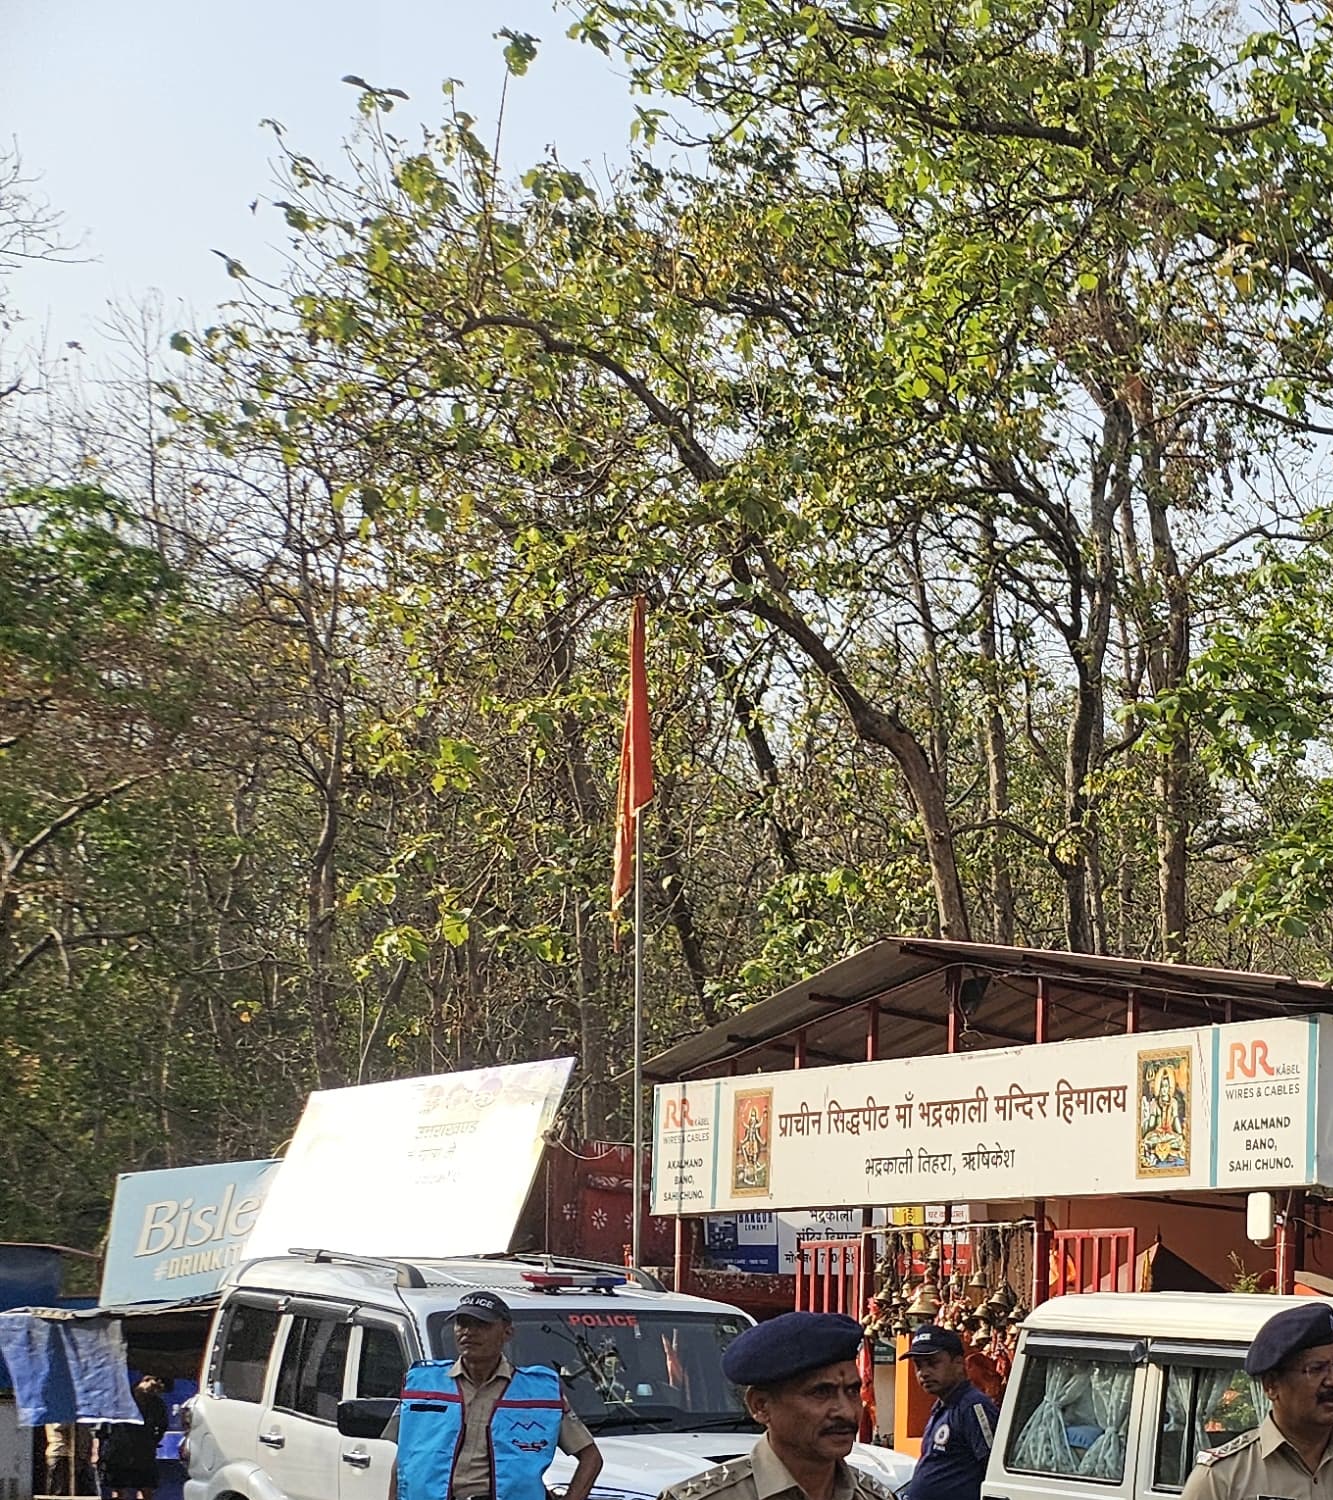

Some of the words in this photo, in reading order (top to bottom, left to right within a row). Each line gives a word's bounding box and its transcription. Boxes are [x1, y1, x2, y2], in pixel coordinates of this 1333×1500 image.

[1225, 1040, 1275, 1081] RR
[1225, 1086, 1254, 1100] WIRES
[1256, 1087, 1262, 1098] &
[1264, 1083, 1300, 1098] CABLES
[663, 1098, 694, 1129] RR
[778, 1101, 822, 1138] प्राचीन
[828, 1096, 889, 1136] सिद्धपीठ
[895, 1090, 914, 1129] माँ
[919, 1085, 988, 1127] भद्रकाली
[994, 1083, 1049, 1122] मन्दिर
[1055, 1079, 1128, 1125] हिमालय
[1233, 1117, 1291, 1132] AKALMAND
[686, 1132, 710, 1143] CABLES
[1245, 1137, 1278, 1151] BANO,
[667, 1158, 703, 1170] AKALMAND
[864, 1146, 914, 1177] भद्रकाली
[918, 1147, 957, 1174] तिहरा,
[962, 1141, 1016, 1173] ऋषिकेश
[1228, 1159, 1252, 1172] SAHI
[1254, 1157, 1294, 1170] CHUNO.
[134, 1184, 264, 1258] Bisle
[567, 1313, 640, 1328] POLICE
